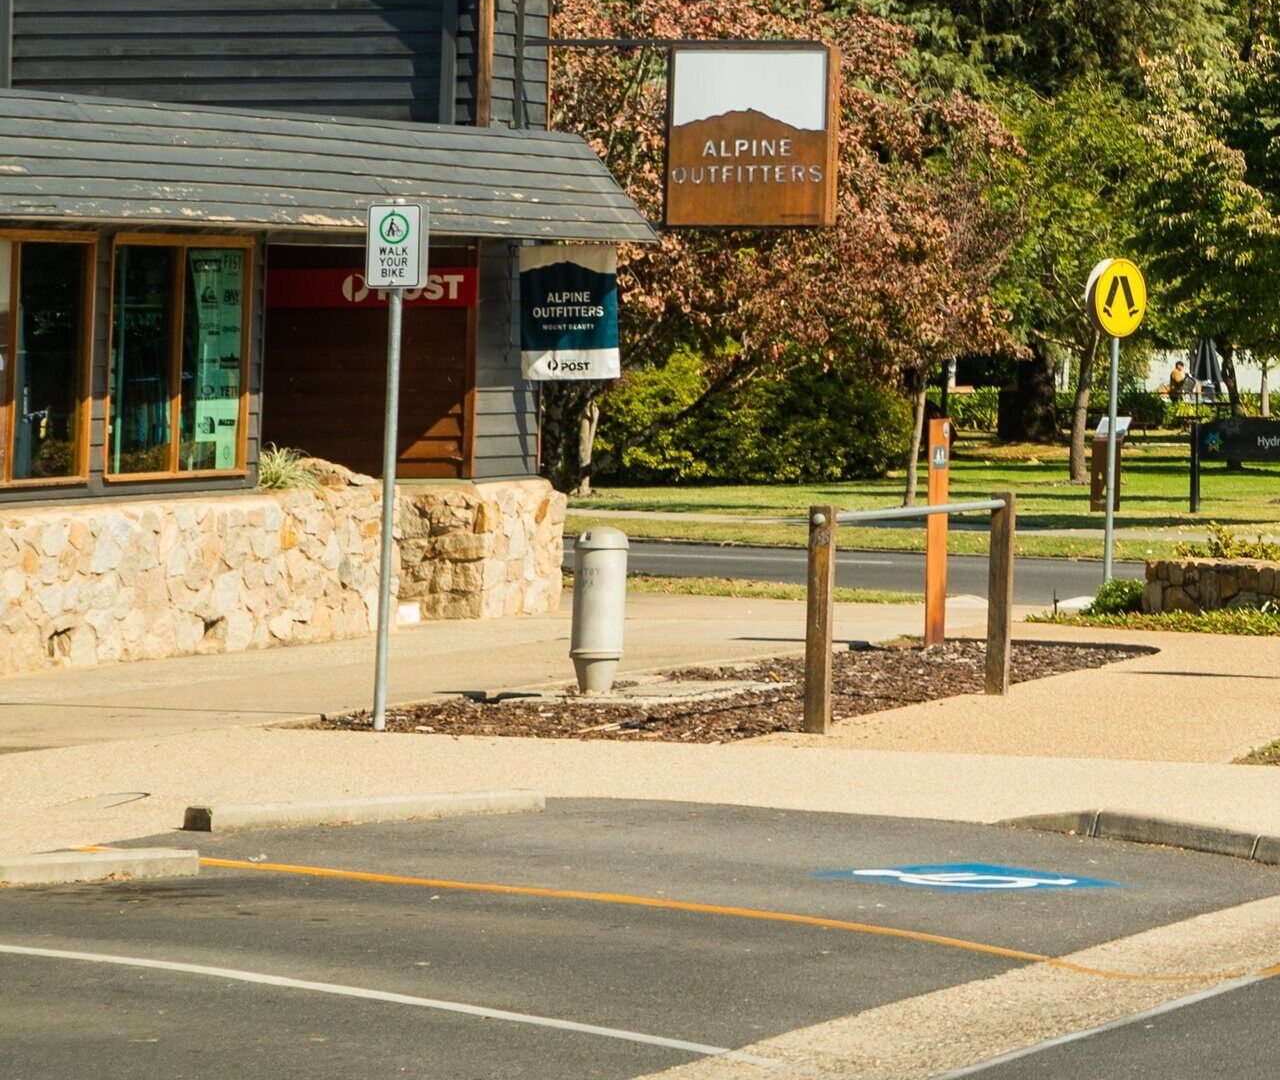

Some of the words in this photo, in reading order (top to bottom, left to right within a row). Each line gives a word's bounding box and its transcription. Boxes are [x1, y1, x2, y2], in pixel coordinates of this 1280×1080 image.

[701, 138, 793, 158] ALPINE
[671, 164, 824, 185] OUTFITTERS
[378, 246, 409, 257] WALK
[379, 257, 409, 268] YOUR
[380, 267, 406, 278] BIKE
[546, 291, 592, 304] ALPINE
[532, 305, 605, 319] OUTFITTERS
[542, 323, 567, 331] MOUNT
[568, 323, 595, 331] BEAUTY
[560, 361, 591, 372] POST
